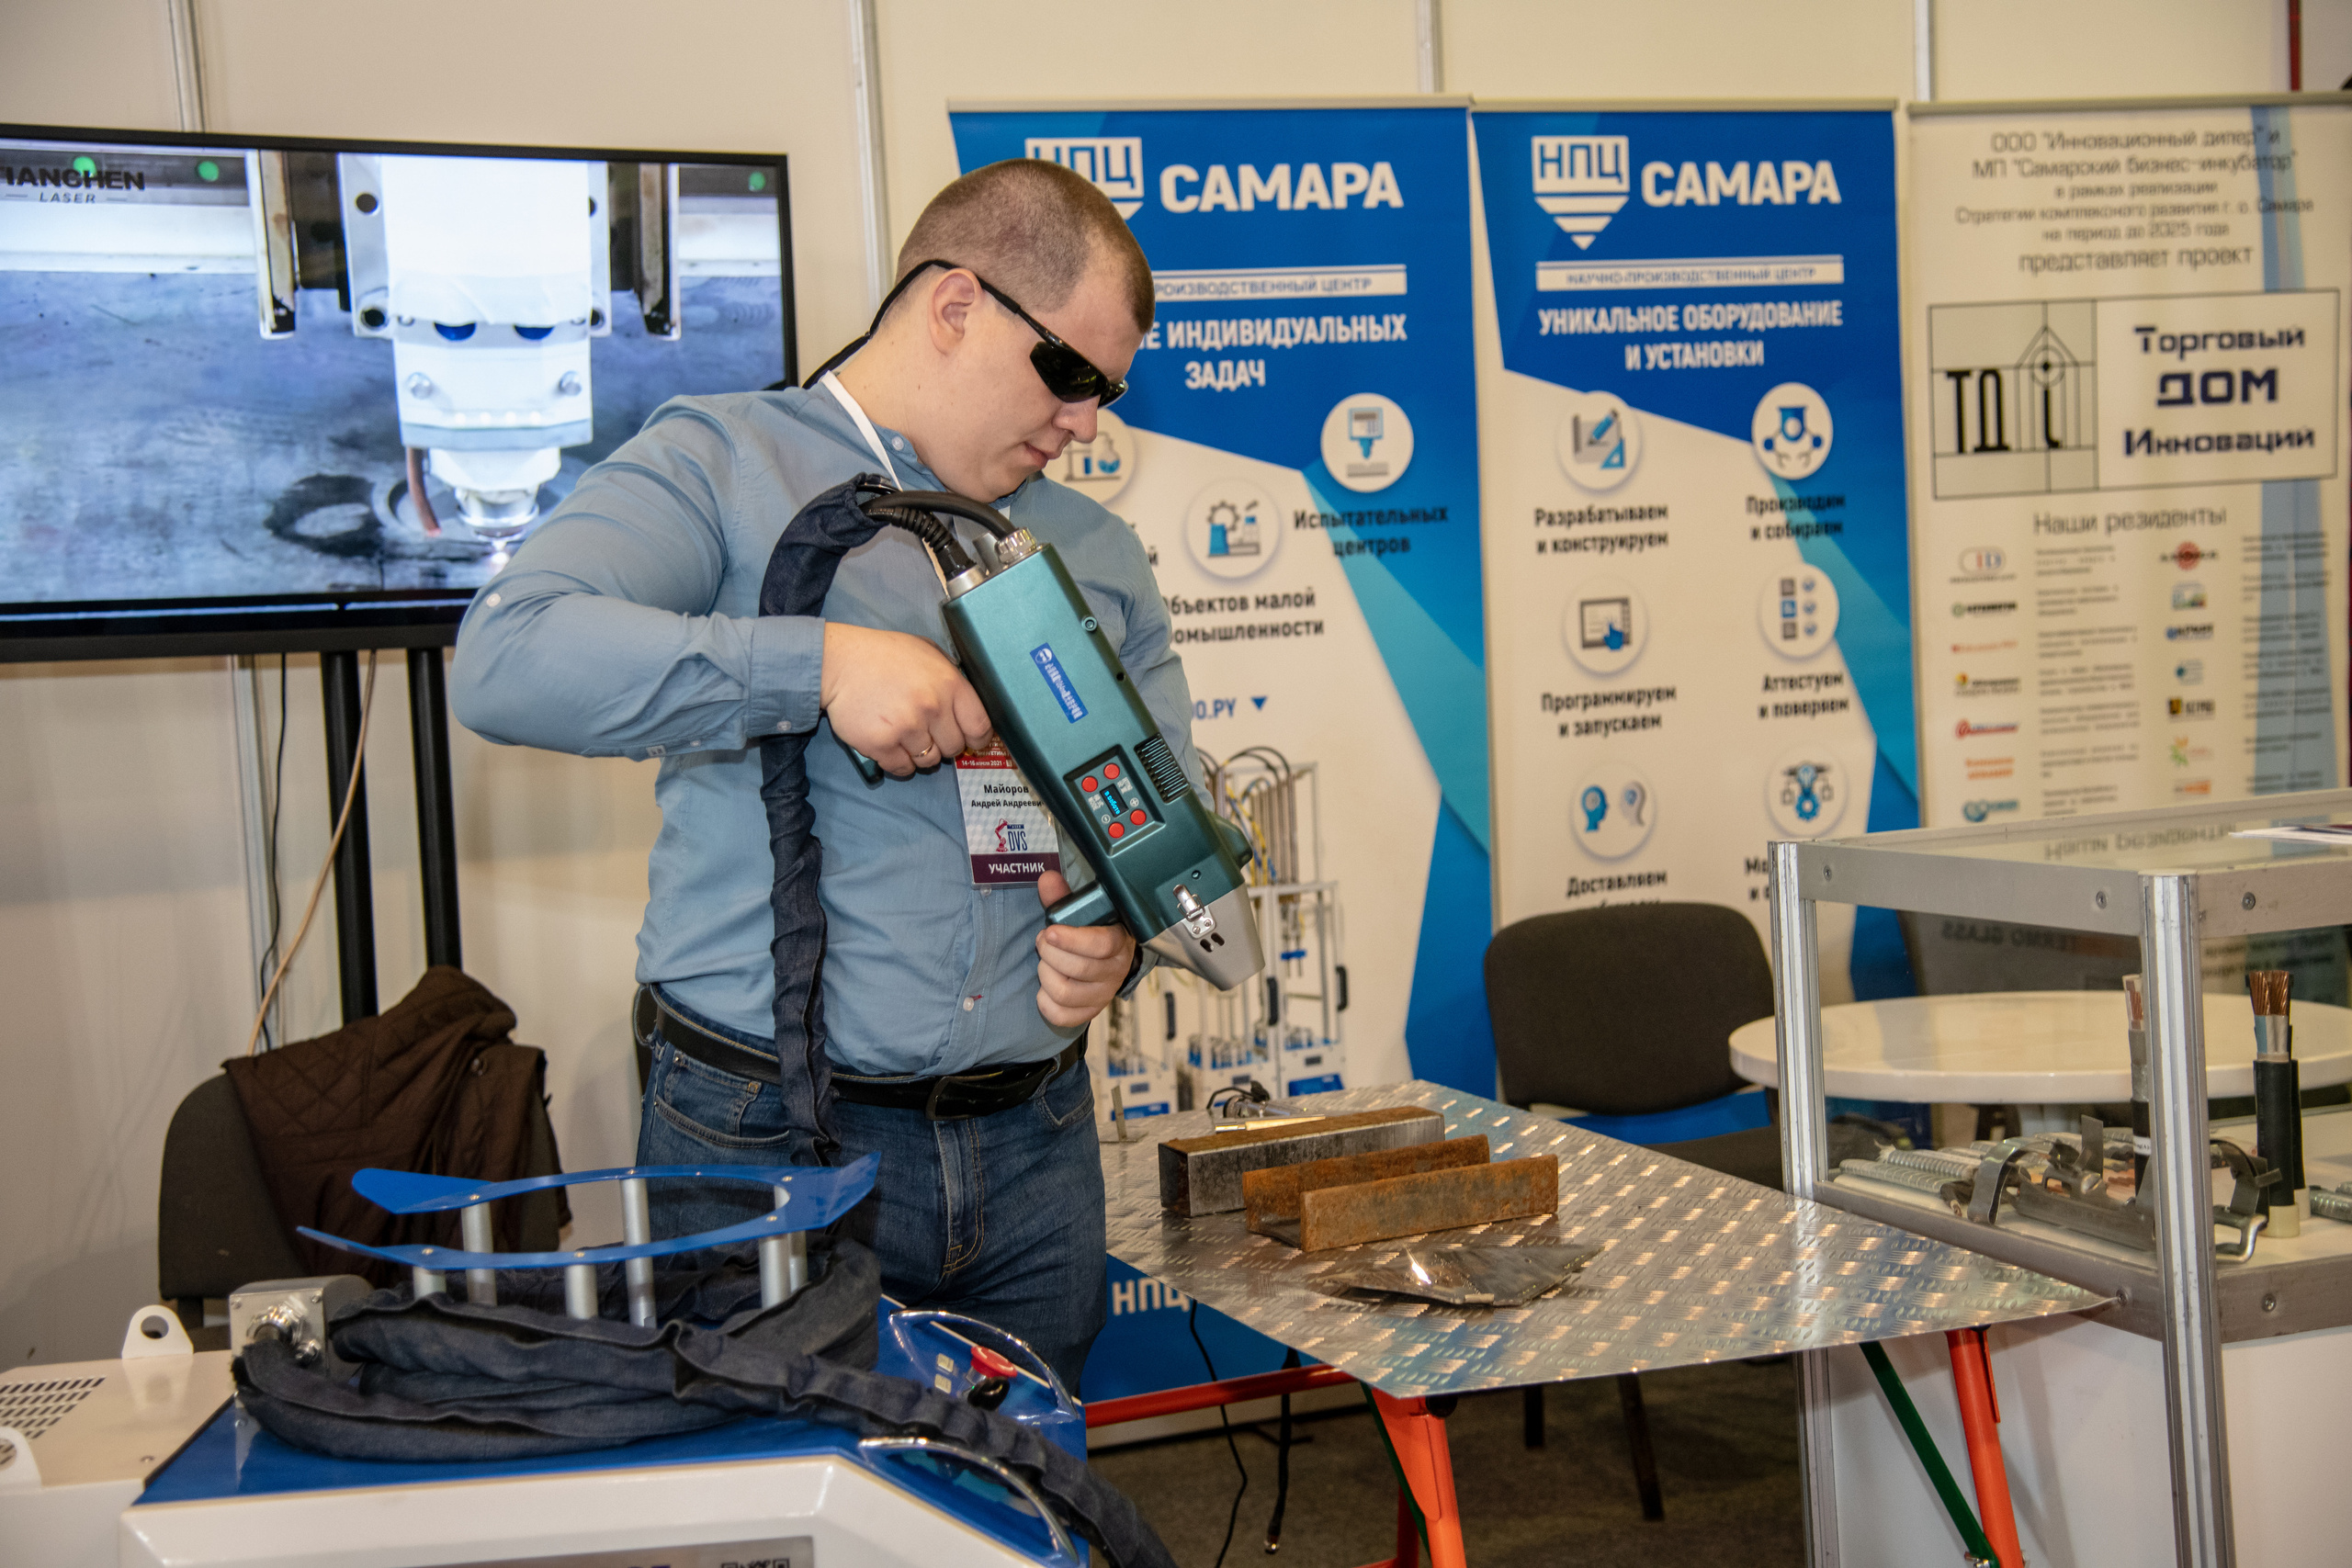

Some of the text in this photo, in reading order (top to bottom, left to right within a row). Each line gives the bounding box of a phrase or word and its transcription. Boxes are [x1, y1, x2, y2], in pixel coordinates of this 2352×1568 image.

[1540, 141, 1842, 208] НПЦ САМАРА
[1973, 160, 2007, 179] МП
[40, 192, 96, 204] LASER
[1159, 161, 1405, 214] САМАРА
[2018, 245, 2254, 275] представляет проект
[1155, 275, 1373, 296] РОИЗВОДСТВЕННЫЙ ЦЕНТР
[1775, 266, 1817, 285] ЦЕНТР
[1538, 299, 1844, 337] УНИКАЛЬНОЕ ОБОРУДОВАНИЕ
[1166, 313, 1408, 352] ИНДИВИДУАЛЬНЫХ
[2133, 324, 2305, 361] Торговый
[1624, 340, 1765, 370] И УСТАНОВКИ
[1184, 358, 1267, 392] ЗАДАЧ
[2124, 425, 2315, 457] Инноваций
[1294, 504, 1449, 532] Испытательных
[1534, 503, 1669, 529] Разрабатываем
[2033, 507, 2227, 536] Наши резиденты
[1537, 530, 1669, 556] и конструируем
[1750, 519, 1844, 541] и собираем
[1332, 536, 1411, 558] центров
[1255, 586, 1317, 611] малой
[1171, 619, 1325, 644] омышленности
[1761, 671, 1844, 694] Аттестуем
[1541, 685, 1678, 715] Программируем
[1758, 705, 1770, 719] и
[1558, 714, 1663, 739] и запускаем
[983, 784, 1030, 795] Майоров
[971, 799, 1001, 808] Андрей
[1008, 830, 1028, 852] DVS
[989, 862, 1046, 874] УЧАСТНИК
[1566, 869, 1668, 899] Доставляем
[1112, 1276, 1191, 1316] НПЦ
